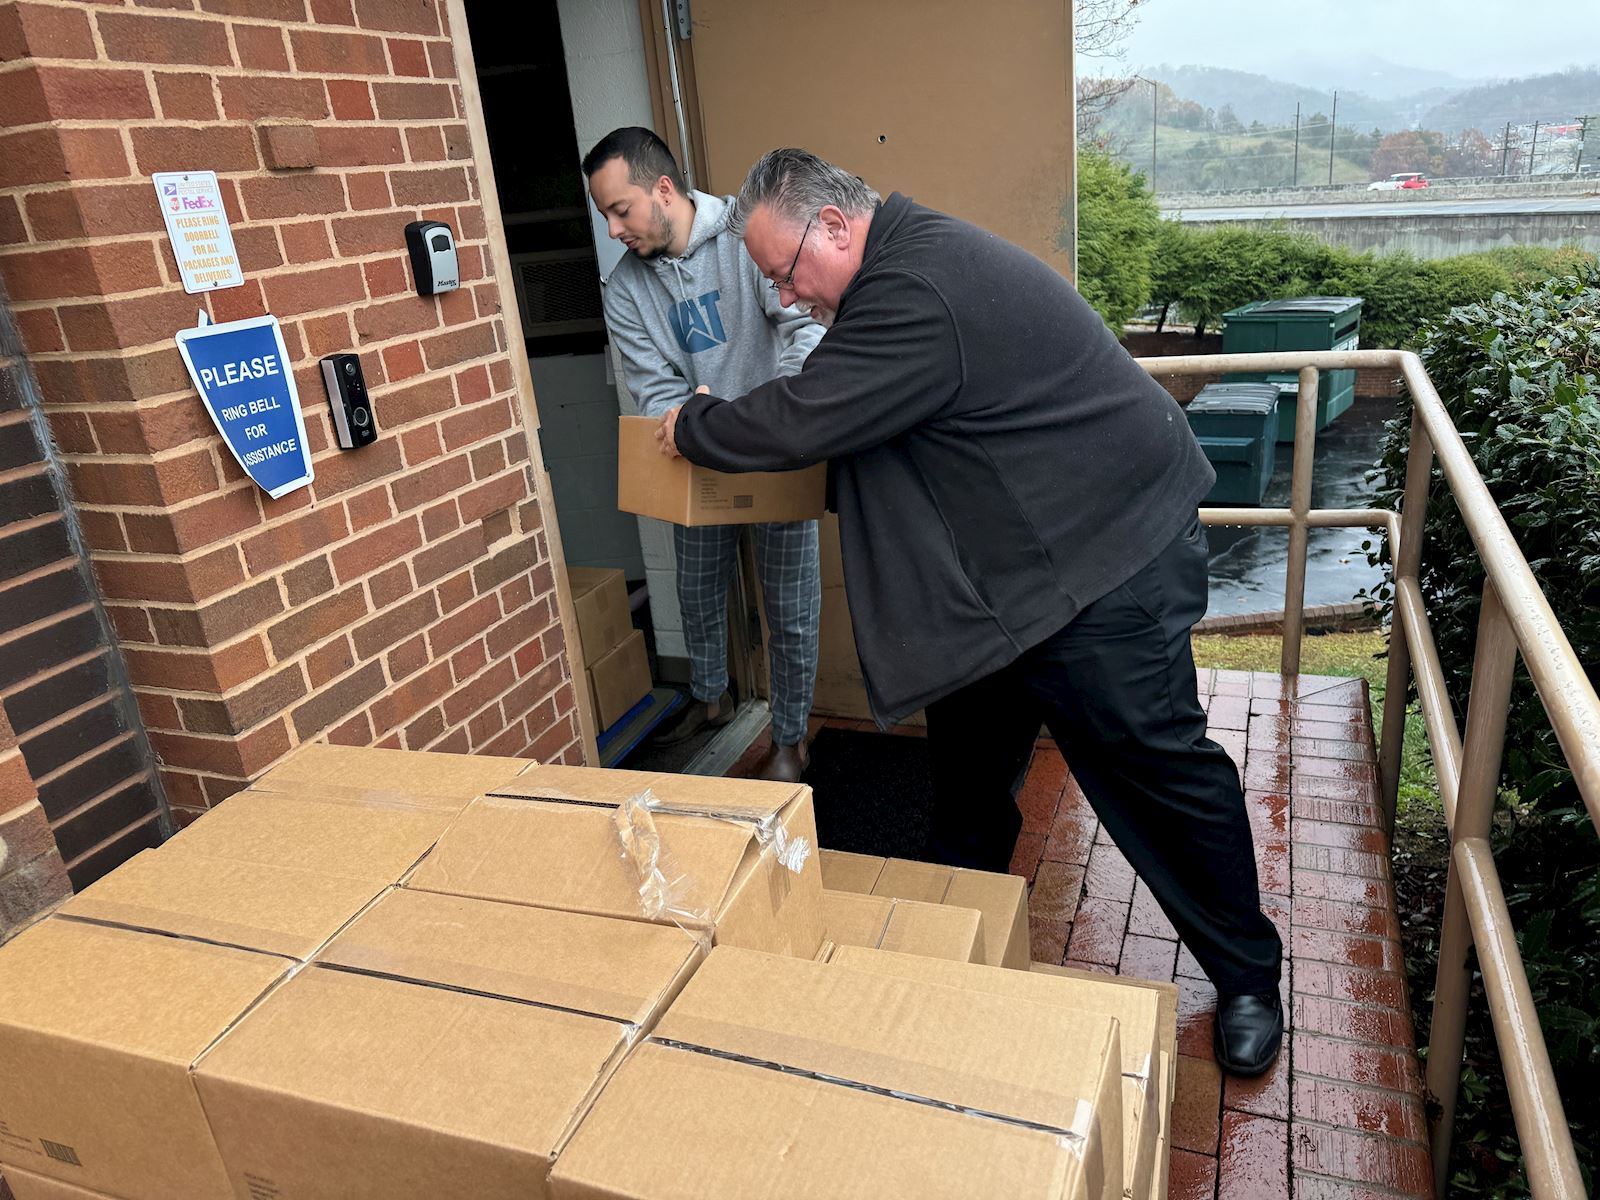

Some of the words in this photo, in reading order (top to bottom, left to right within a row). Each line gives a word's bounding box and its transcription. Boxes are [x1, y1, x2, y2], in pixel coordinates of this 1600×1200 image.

[182, 196, 214, 209] FedEx
[176, 217, 202, 229] PLEASE
[202, 215, 219, 226] RING
[184, 230, 219, 241] DOORBELL
[192, 244, 207, 255] FOR
[207, 243, 219, 254] ALL
[183, 257, 220, 270] PACKAGES
[221, 256, 234, 265] AND
[194, 269, 232, 283] DELIVERIES
[200, 355, 279, 389] PLEASE
[221, 404, 248, 422] RING
[249, 396, 281, 415] BELL
[244, 423, 268, 441] FOR
[242, 438, 297, 467] ASSISTANCE
